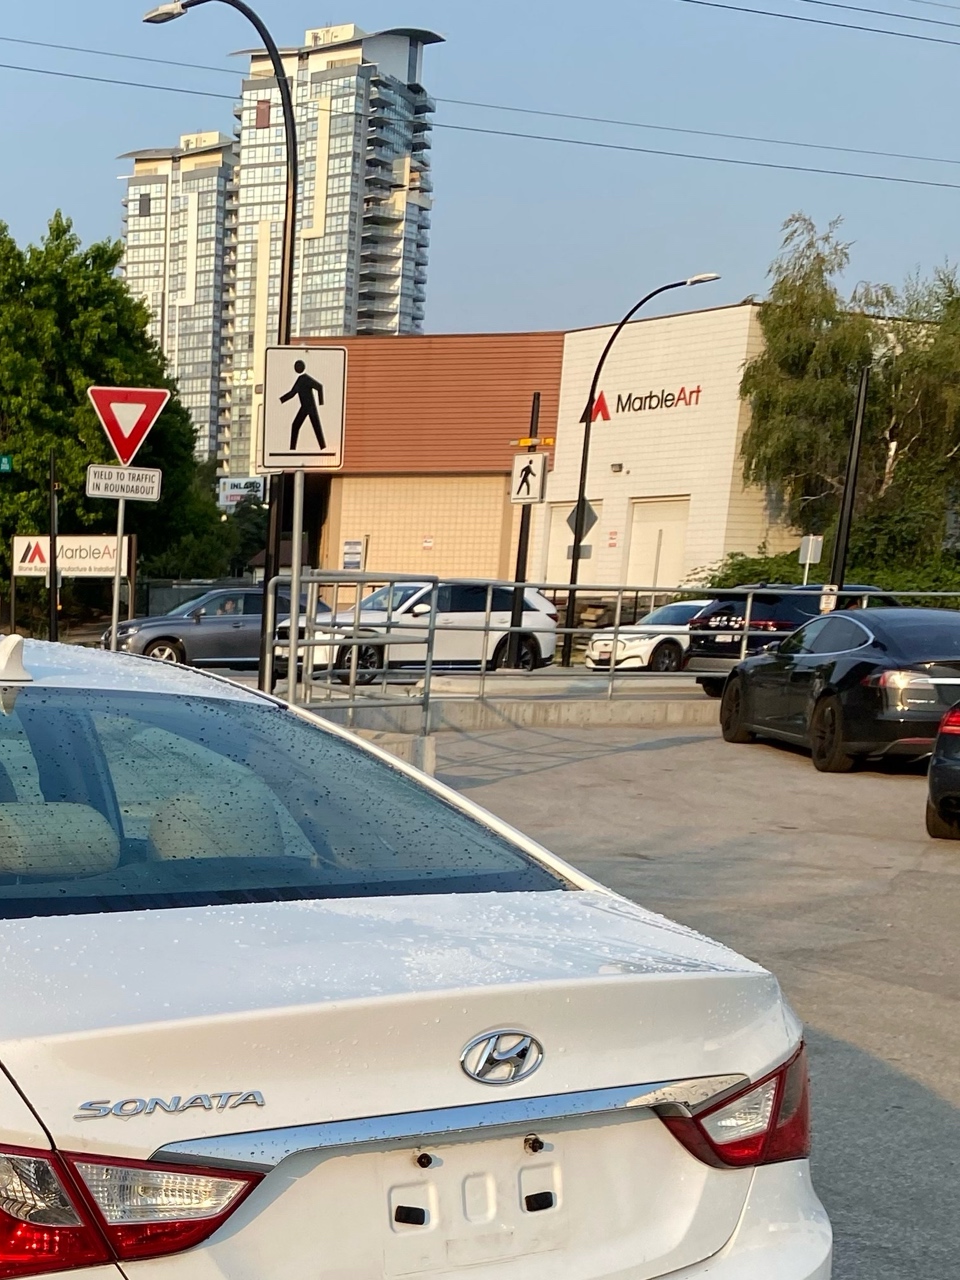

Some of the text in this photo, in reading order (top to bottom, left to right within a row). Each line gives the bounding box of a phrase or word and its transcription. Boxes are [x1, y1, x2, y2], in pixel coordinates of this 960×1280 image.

[615, 385, 703, 413] MarbleArt
[93, 470, 156, 484] YIELD TO TRAFFIC
[92, 482, 155, 495] IN ROUNDABOUT
[56, 545, 117, 560] MarbleAr
[73, 1090, 266, 1120] SONATA
